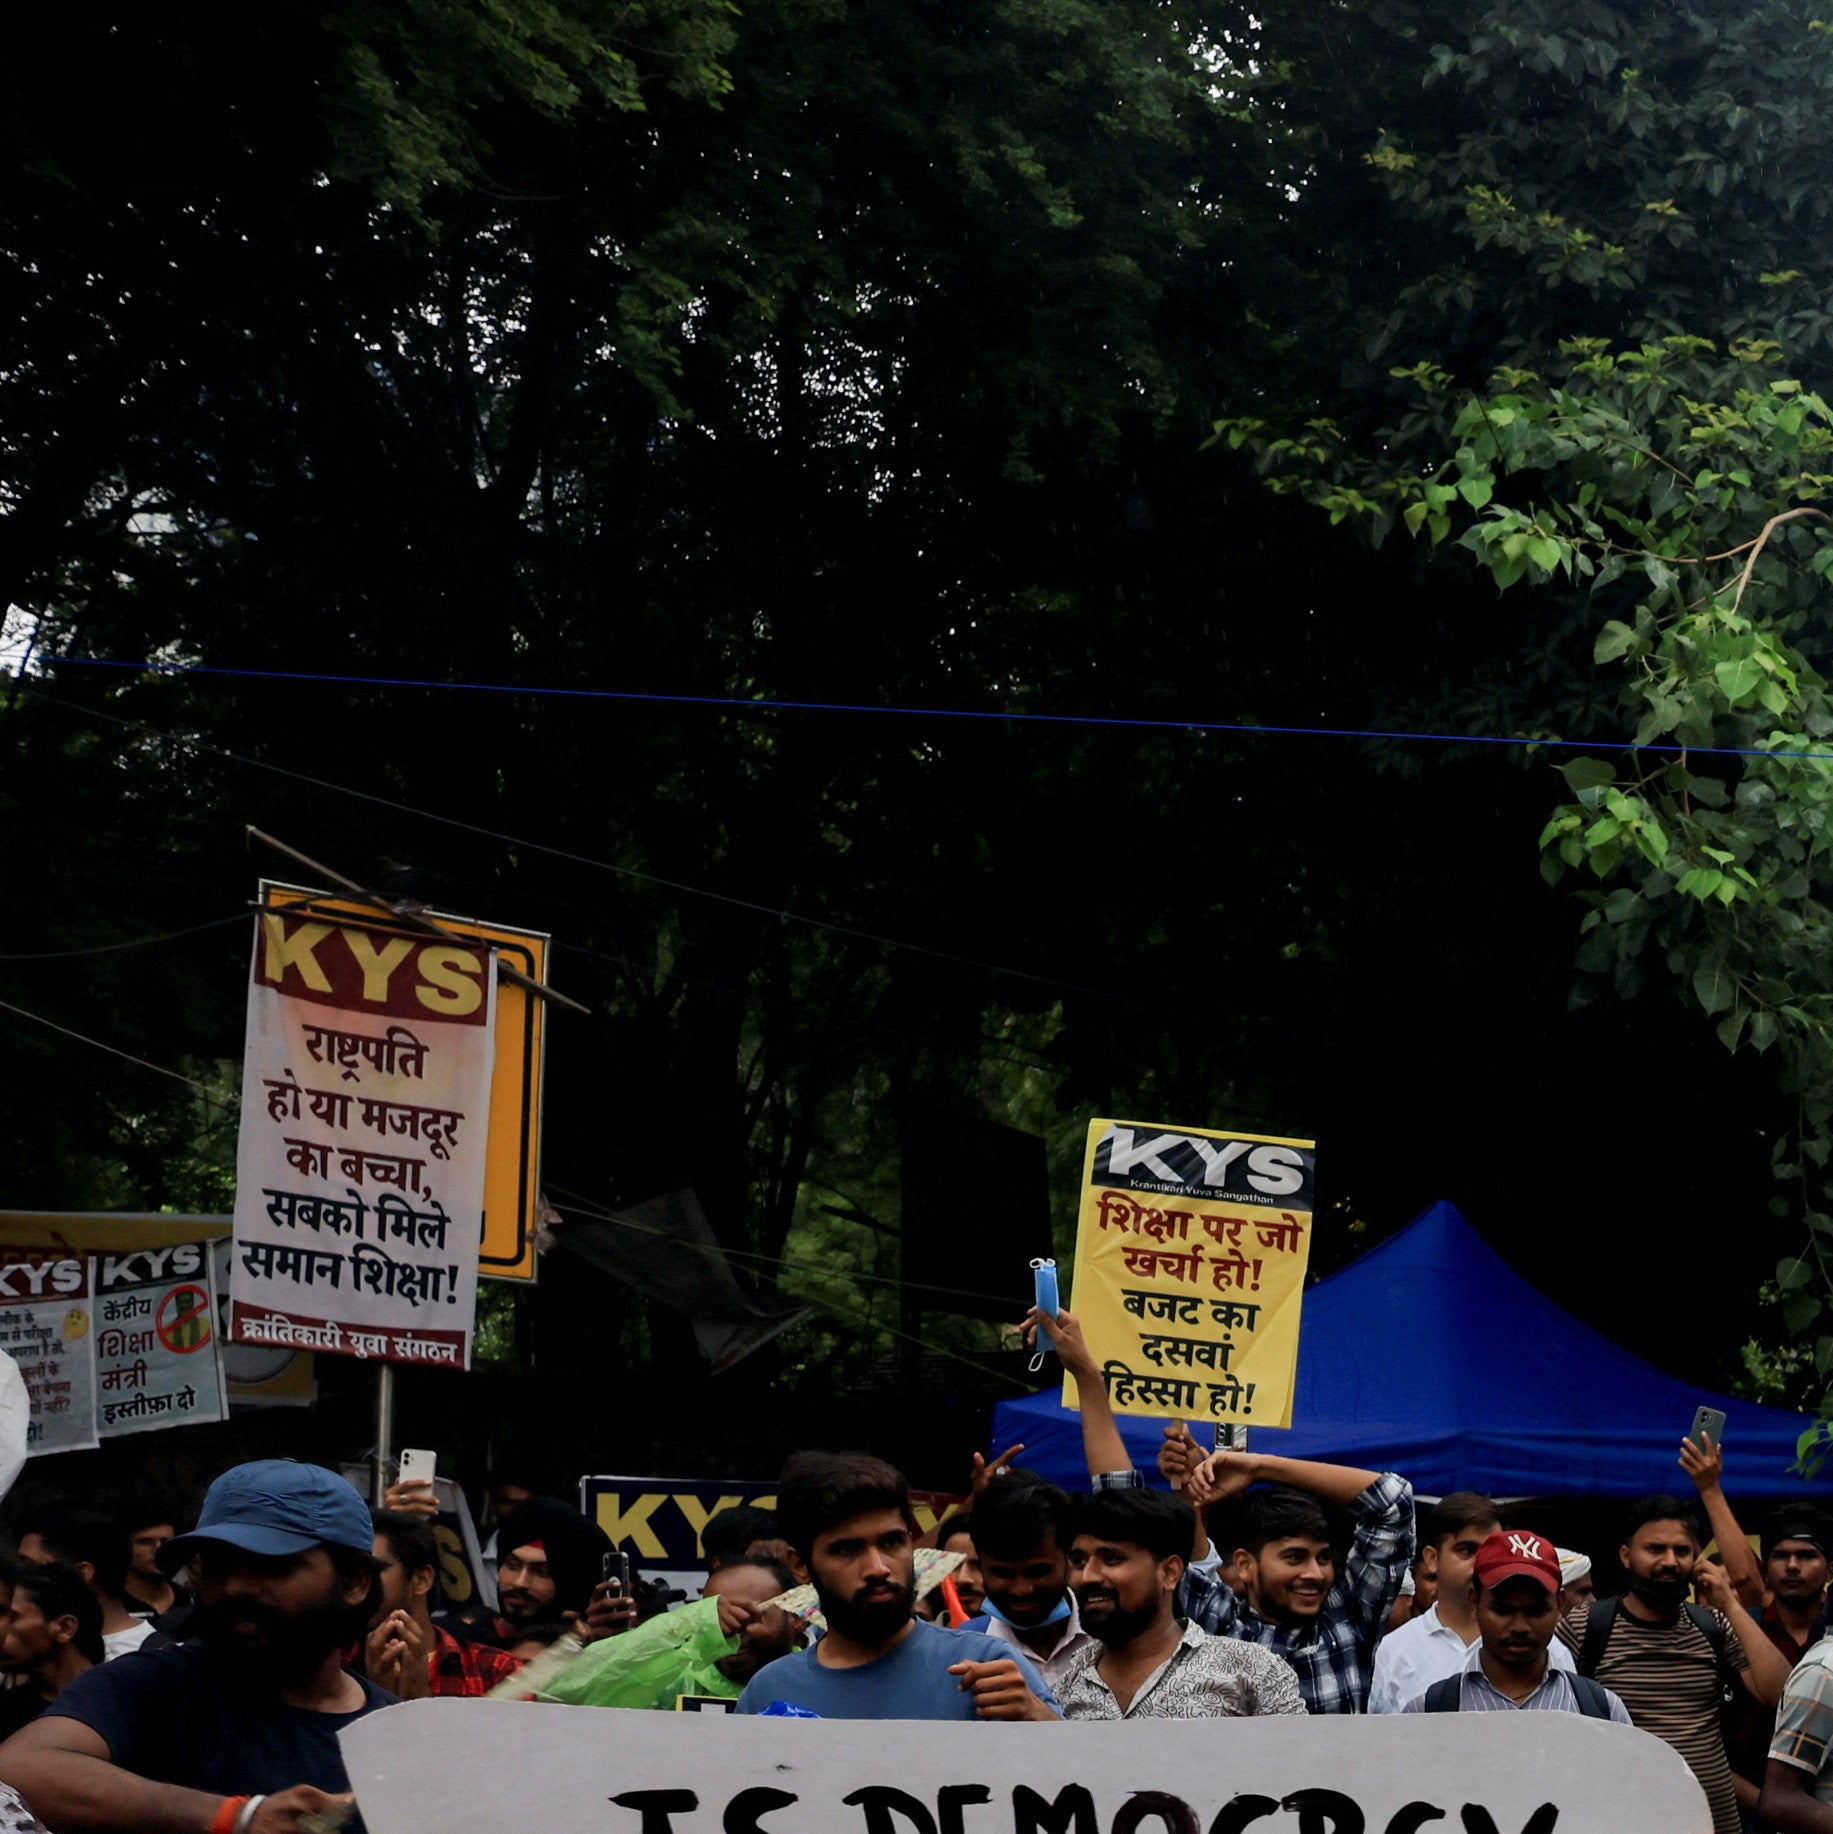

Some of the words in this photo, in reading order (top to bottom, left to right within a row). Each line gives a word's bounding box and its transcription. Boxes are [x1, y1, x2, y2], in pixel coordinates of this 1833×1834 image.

[263, 911, 483, 1017] KYS
[302, 1024, 430, 1083] राष्ट्रपति
[262, 1067, 303, 1123] हो
[305, 1088, 355, 1131] या
[357, 1097, 466, 1161] मजदूर
[283, 1137, 335, 1181] का
[337, 1147, 433, 1203] बच्चा,
[1107, 1126, 1305, 1196] KYS
[1130, 1178, 1184, 1195] Krantikari
[1186, 1186, 1212, 1198] Yuva
[1214, 1188, 1274, 1205] Sangathan
[262, 1187, 370, 1239] सबको
[374, 1192, 453, 1250] मिले
[1096, 1191, 1195, 1244] शिक्षा
[1200, 1213, 1249, 1248] पर
[1253, 1212, 1305, 1254] जो
[102, 1244, 201, 1287] KYS
[238, 1240, 346, 1289] समान
[349, 1242, 461, 1308] शिक्षा!
[1121, 1244, 1205, 1284] खर्चा
[1209, 1248, 1264, 1292] हो!
[103, 1297, 152, 1322] केंद्रीय
[1121, 1288, 1205, 1325] बजट
[1209, 1298, 1262, 1333] का
[98, 1329, 155, 1359] शिक्षा
[240, 1313, 344, 1349] क्रांतिकारी
[347, 1330, 389, 1358] युवा
[392, 1332, 459, 1362] संगठन
[1139, 1332, 1236, 1372] दसवां
[101, 1358, 148, 1391] मंत्री
[176, 1385, 196, 1411] दो
[1101, 1359, 1201, 1410] हिस्सा
[1206, 1373, 1257, 1417] हो!
[596, 1492, 778, 1559] KY
